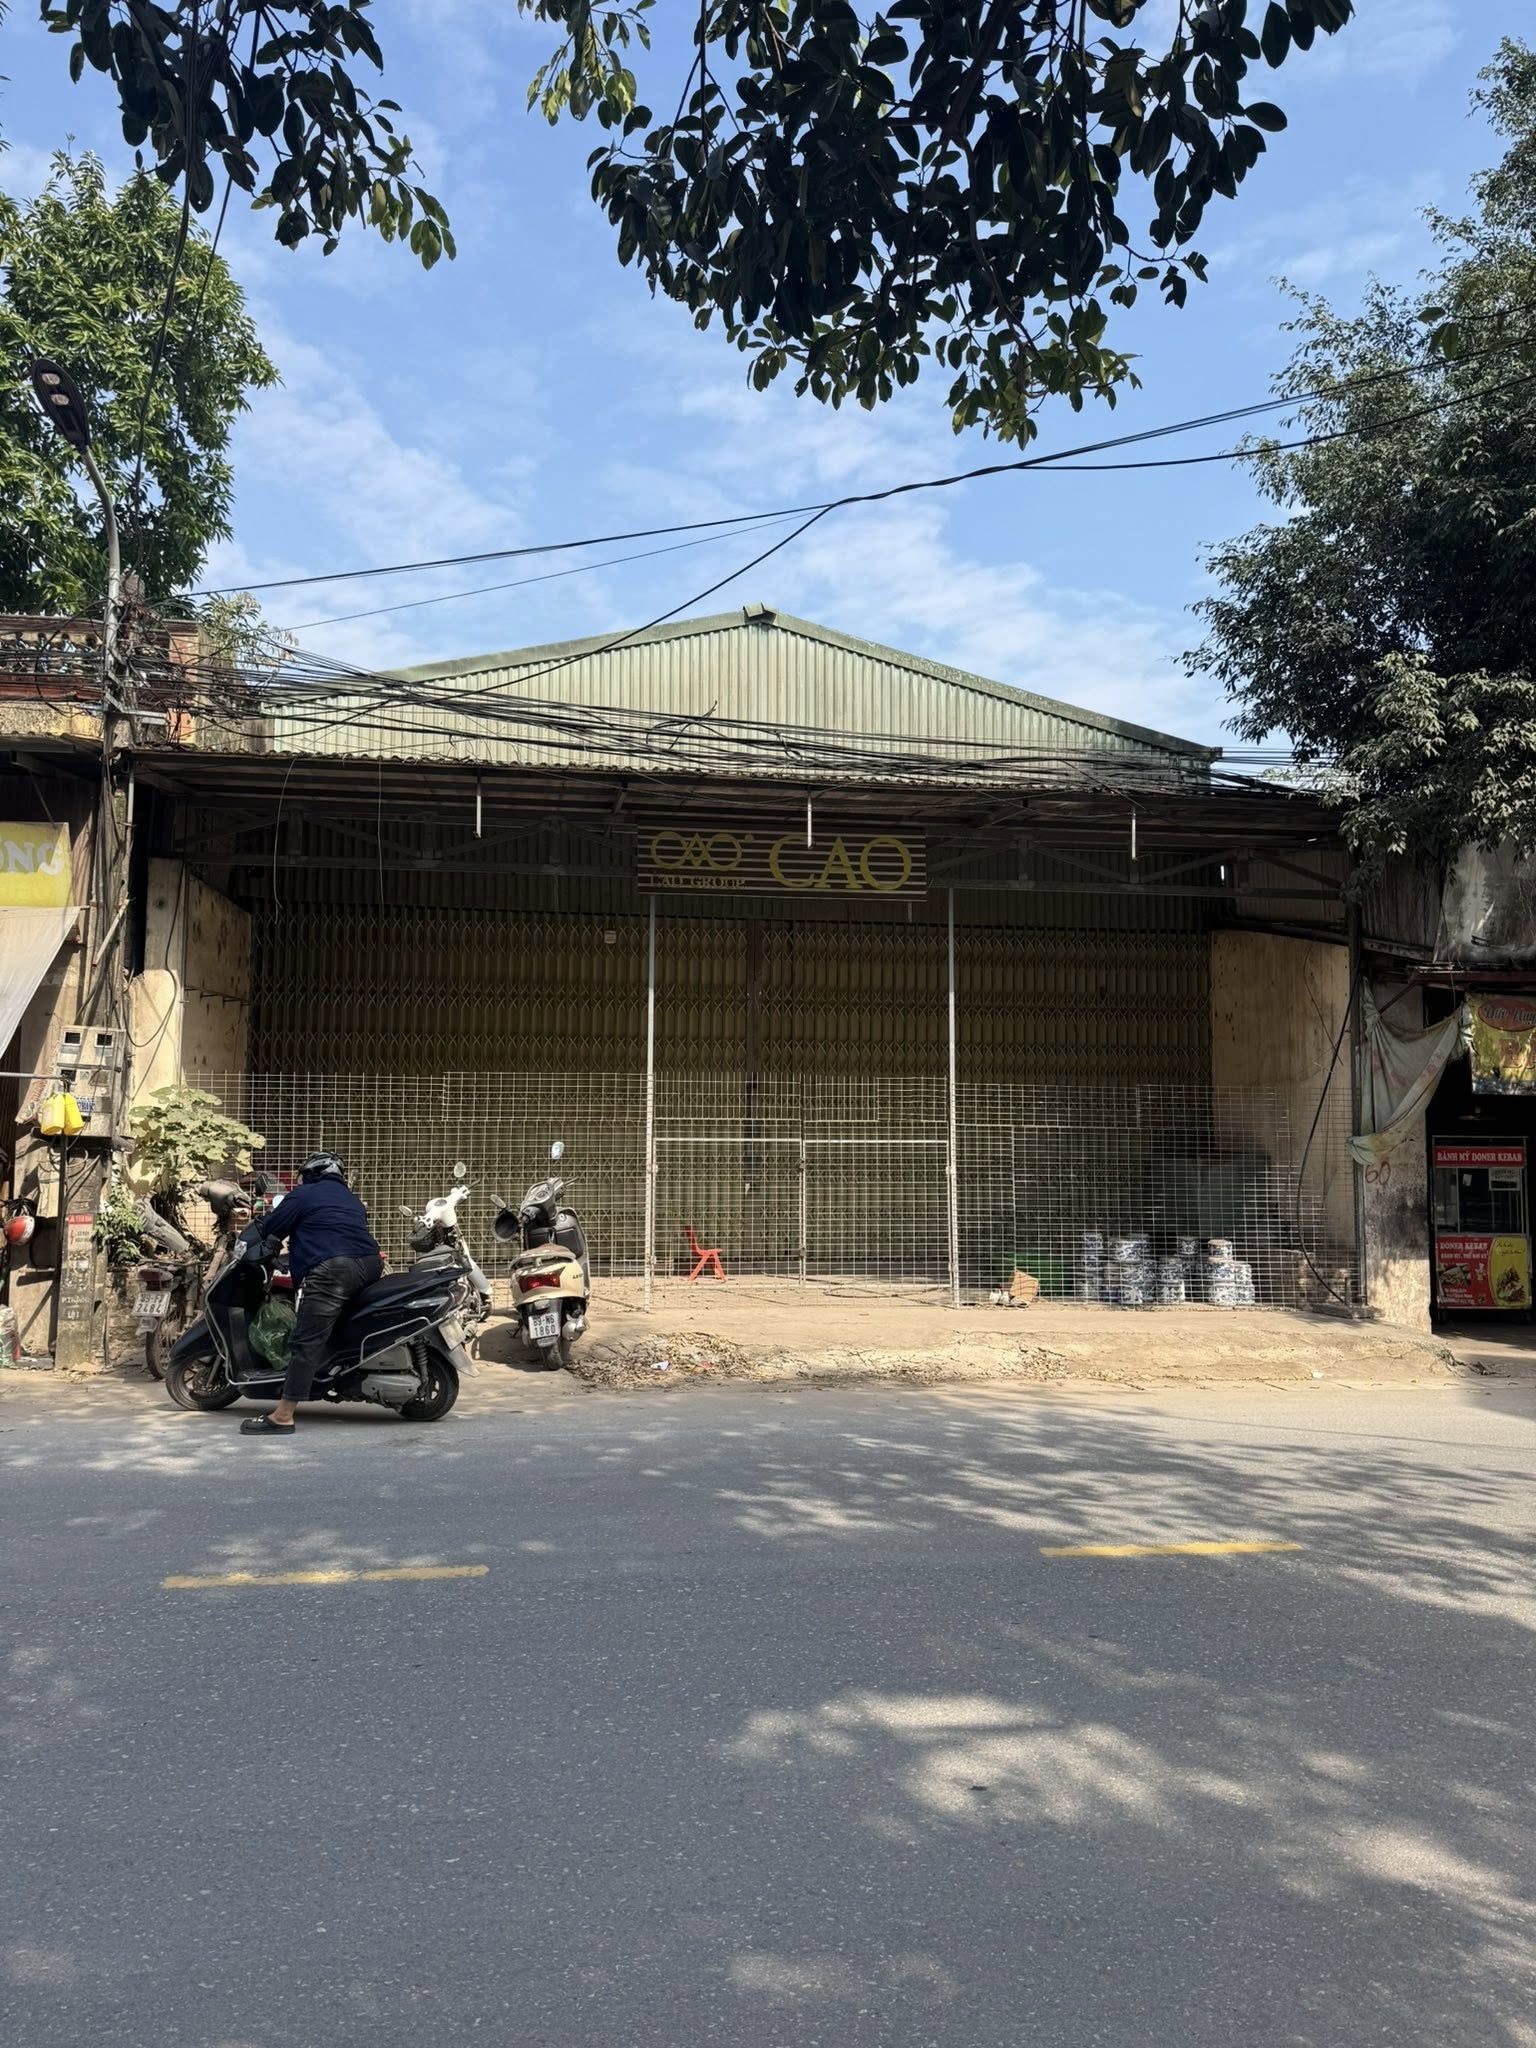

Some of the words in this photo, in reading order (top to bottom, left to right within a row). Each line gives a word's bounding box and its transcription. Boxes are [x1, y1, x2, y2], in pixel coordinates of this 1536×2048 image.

[769, 834, 912, 891] CAO
[1471, 1152, 1497, 1162] DONER
[1497, 1153, 1522, 1163] KEBAB
[534, 1324, 556, 1336] 1860
